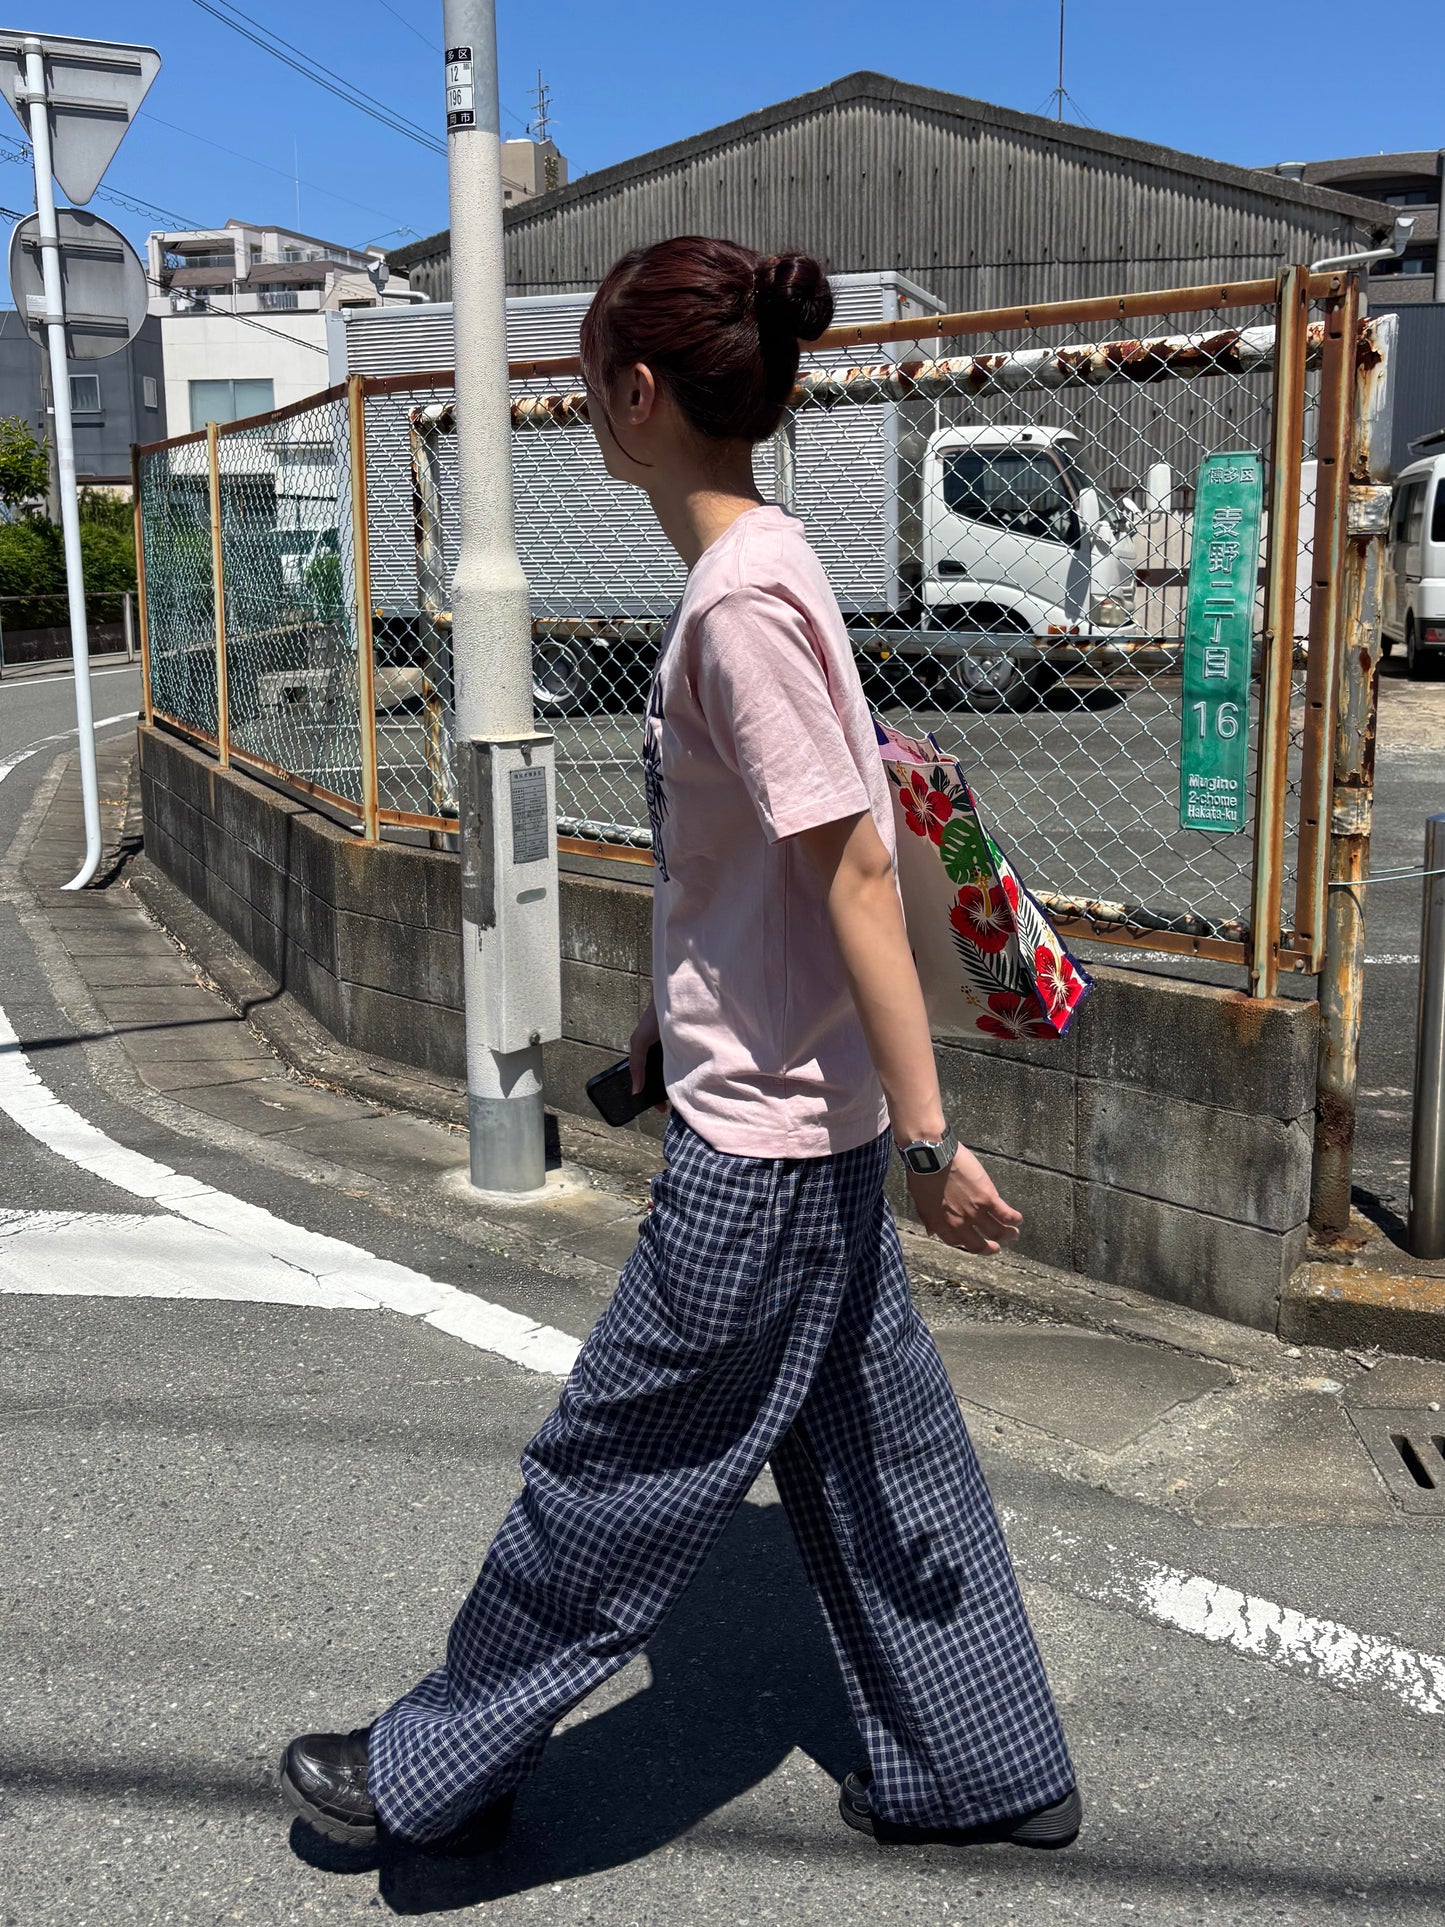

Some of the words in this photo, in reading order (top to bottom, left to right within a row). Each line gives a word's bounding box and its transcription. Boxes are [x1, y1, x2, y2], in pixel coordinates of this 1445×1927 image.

[450, 65, 459, 82] 12
[449, 89, 462, 107] 196
[1208, 466, 1255, 484] 博多区
[1203, 506, 1243, 678] 麦野二丁目
[1192, 701, 1239, 739] 16
[1188, 773, 1238, 791] Mugino
[1188, 791, 1238, 808] 2-chome
[1187, 804, 1238, 821] Hakata-ku
